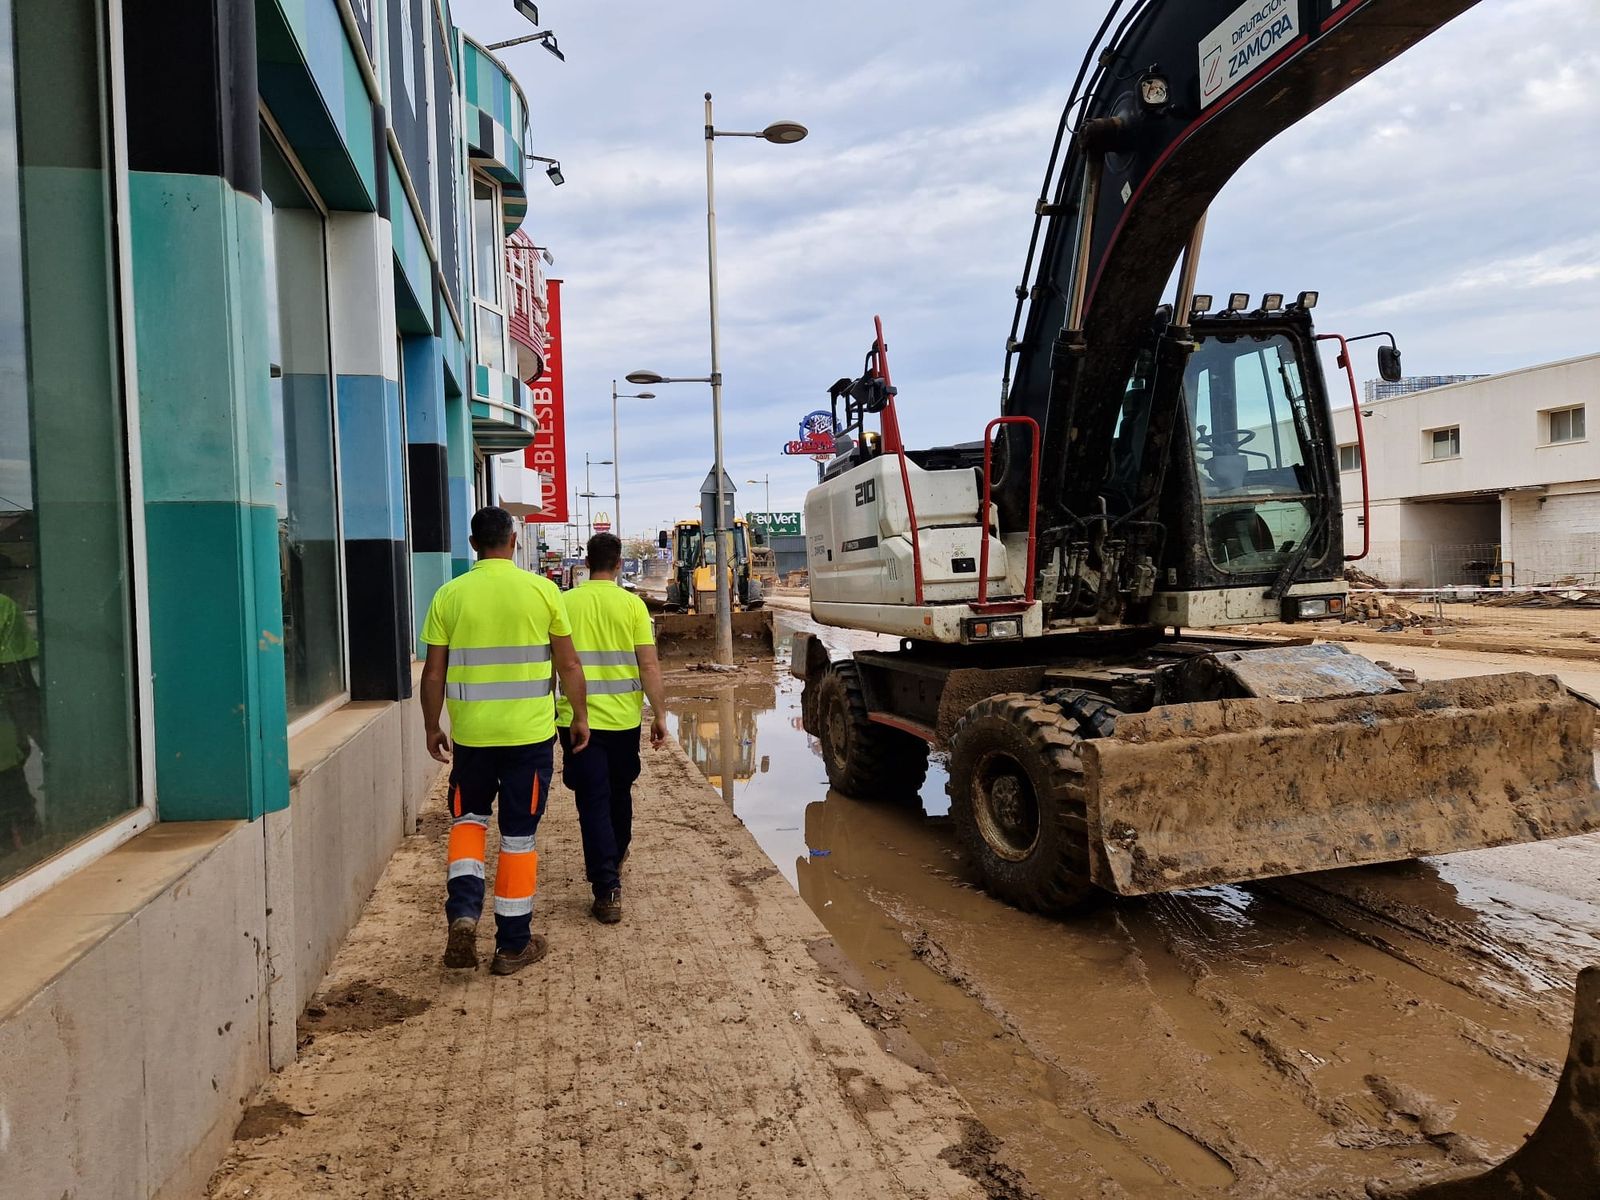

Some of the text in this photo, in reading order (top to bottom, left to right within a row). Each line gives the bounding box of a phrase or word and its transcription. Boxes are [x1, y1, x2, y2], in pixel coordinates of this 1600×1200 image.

[1228, 14, 1293, 78] ZAMORA
[855, 478, 875, 507] 210
[773, 513, 797, 524] Vert
